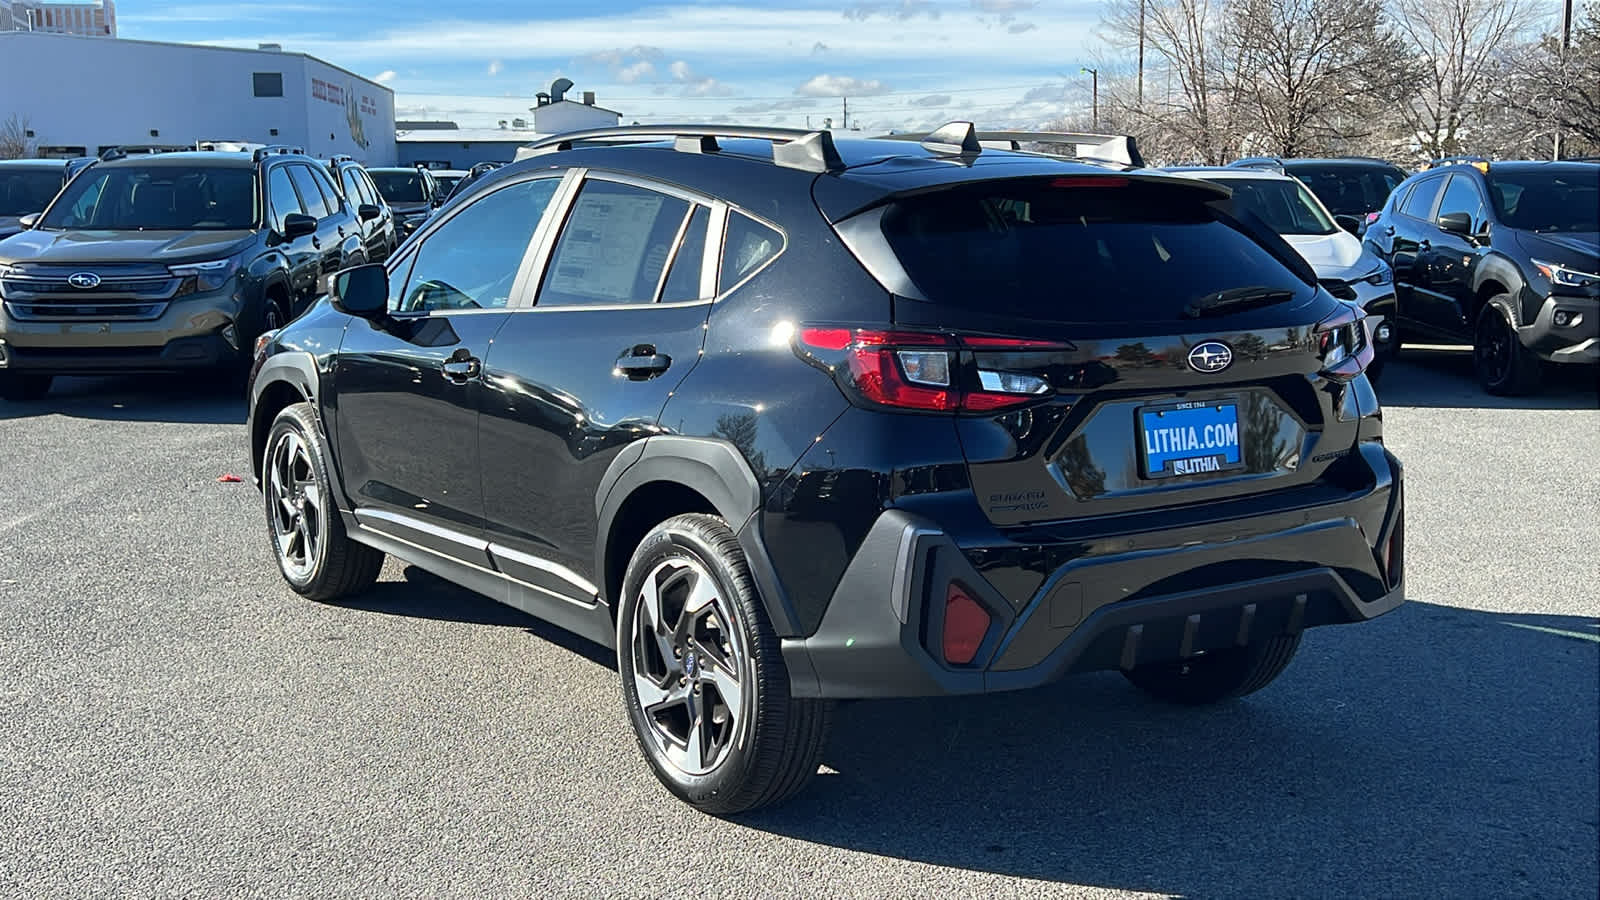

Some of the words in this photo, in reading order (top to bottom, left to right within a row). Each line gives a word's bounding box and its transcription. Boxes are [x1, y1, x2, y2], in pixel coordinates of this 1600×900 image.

[1176, 402, 1193, 410] SINCE
[1145, 422, 1239, 454] LITHIA.COM
[1183, 456, 1220, 474] LITHIA
